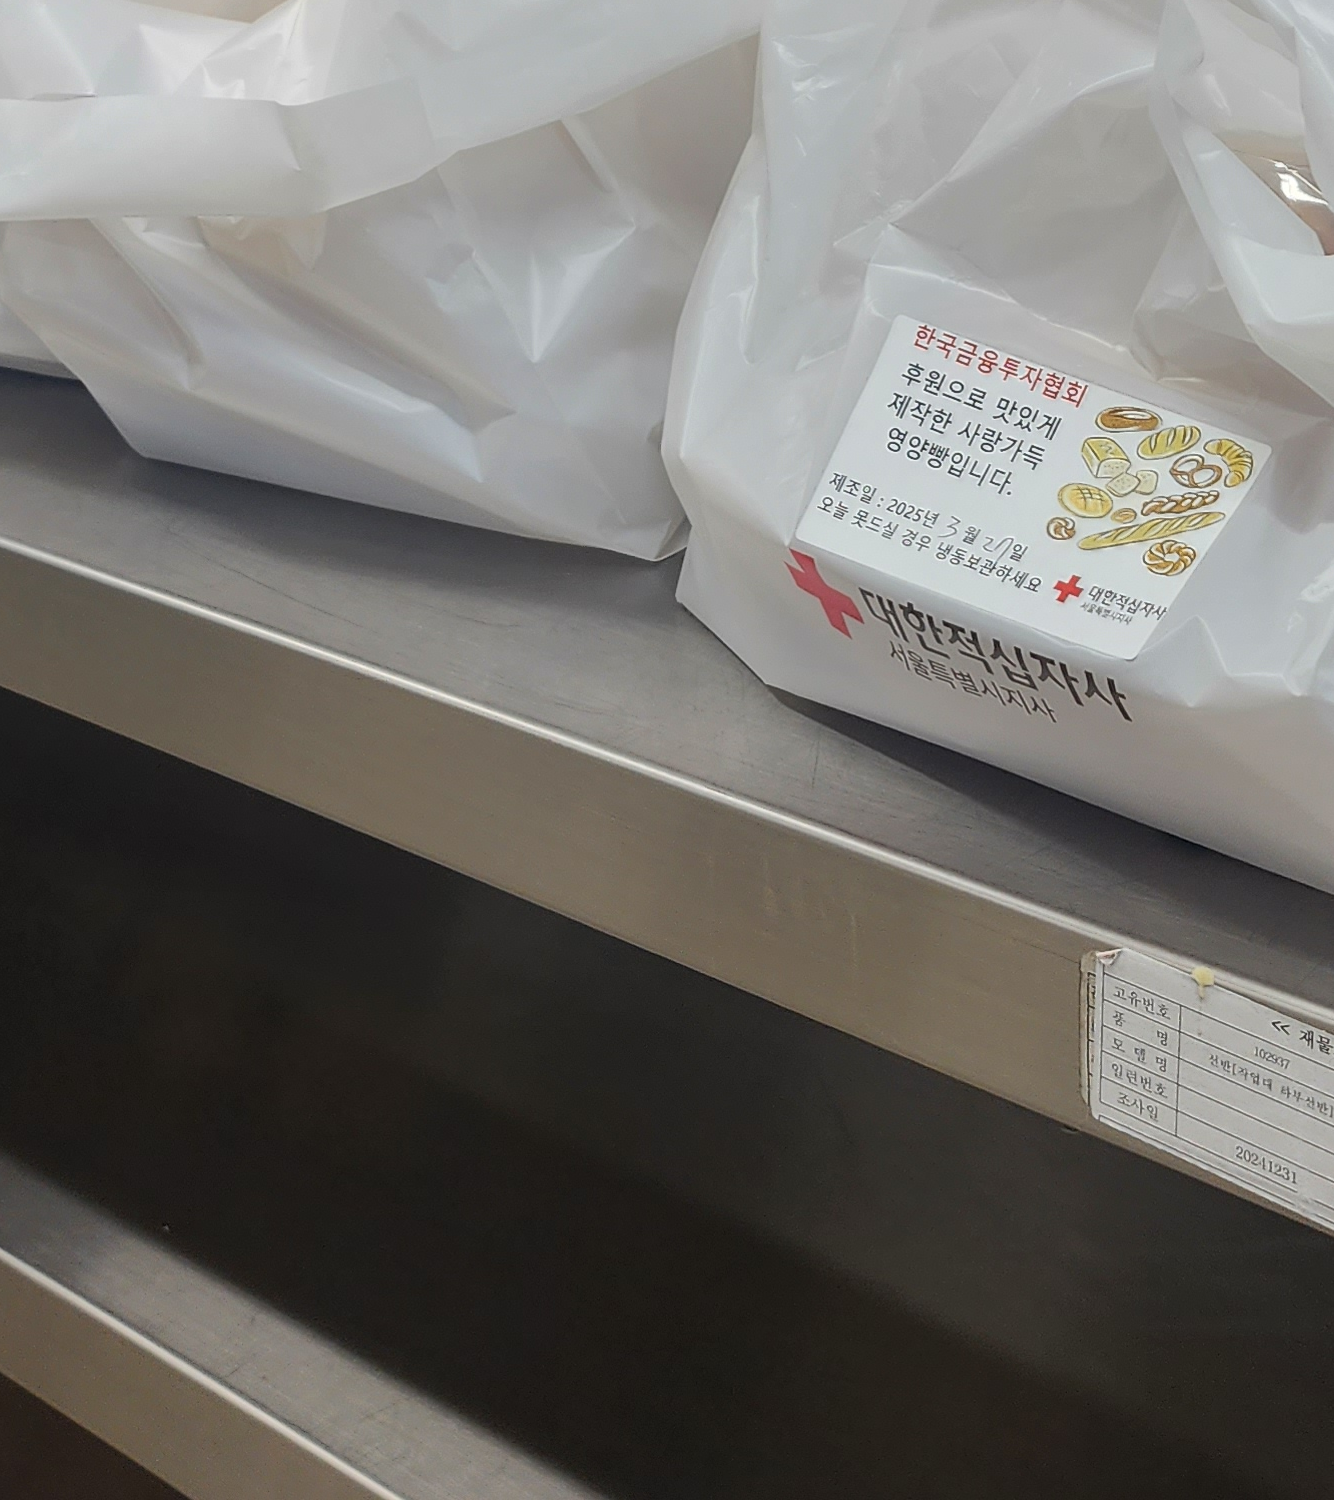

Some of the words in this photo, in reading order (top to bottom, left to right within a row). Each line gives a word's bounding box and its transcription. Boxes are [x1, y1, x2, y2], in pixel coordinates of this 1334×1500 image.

[901, 362, 987, 411] 후원으로
[992, 397, 1063, 441] 맛있게
[914, 324, 1089, 409] 한국금융투자협회
[886, 427, 1013, 497] 영양빵입니다.
[887, 392, 953, 435] 제작한
[957, 421, 1046, 471] 사랑가득
[816, 496, 850, 520] 오늘
[851, 509, 900, 540] 못드실
[901, 529, 932, 553] 경우
[935, 541, 1042, 593] 냉동보관하세요
[885, 498, 941, 529] 2025년
[1088, 585, 1167, 620] 대한적십자사
[858, 586, 1133, 723] 대한적십자사
[889, 640, 1057, 724] 서울특별시지사
[1112, 986, 1171, 1020] 고유번호
[1111, 1062, 1169, 1099] 일련번호
[1117, 1091, 1159, 1123] 조사일
[1234, 1145, 1299, 1185] 20241231
